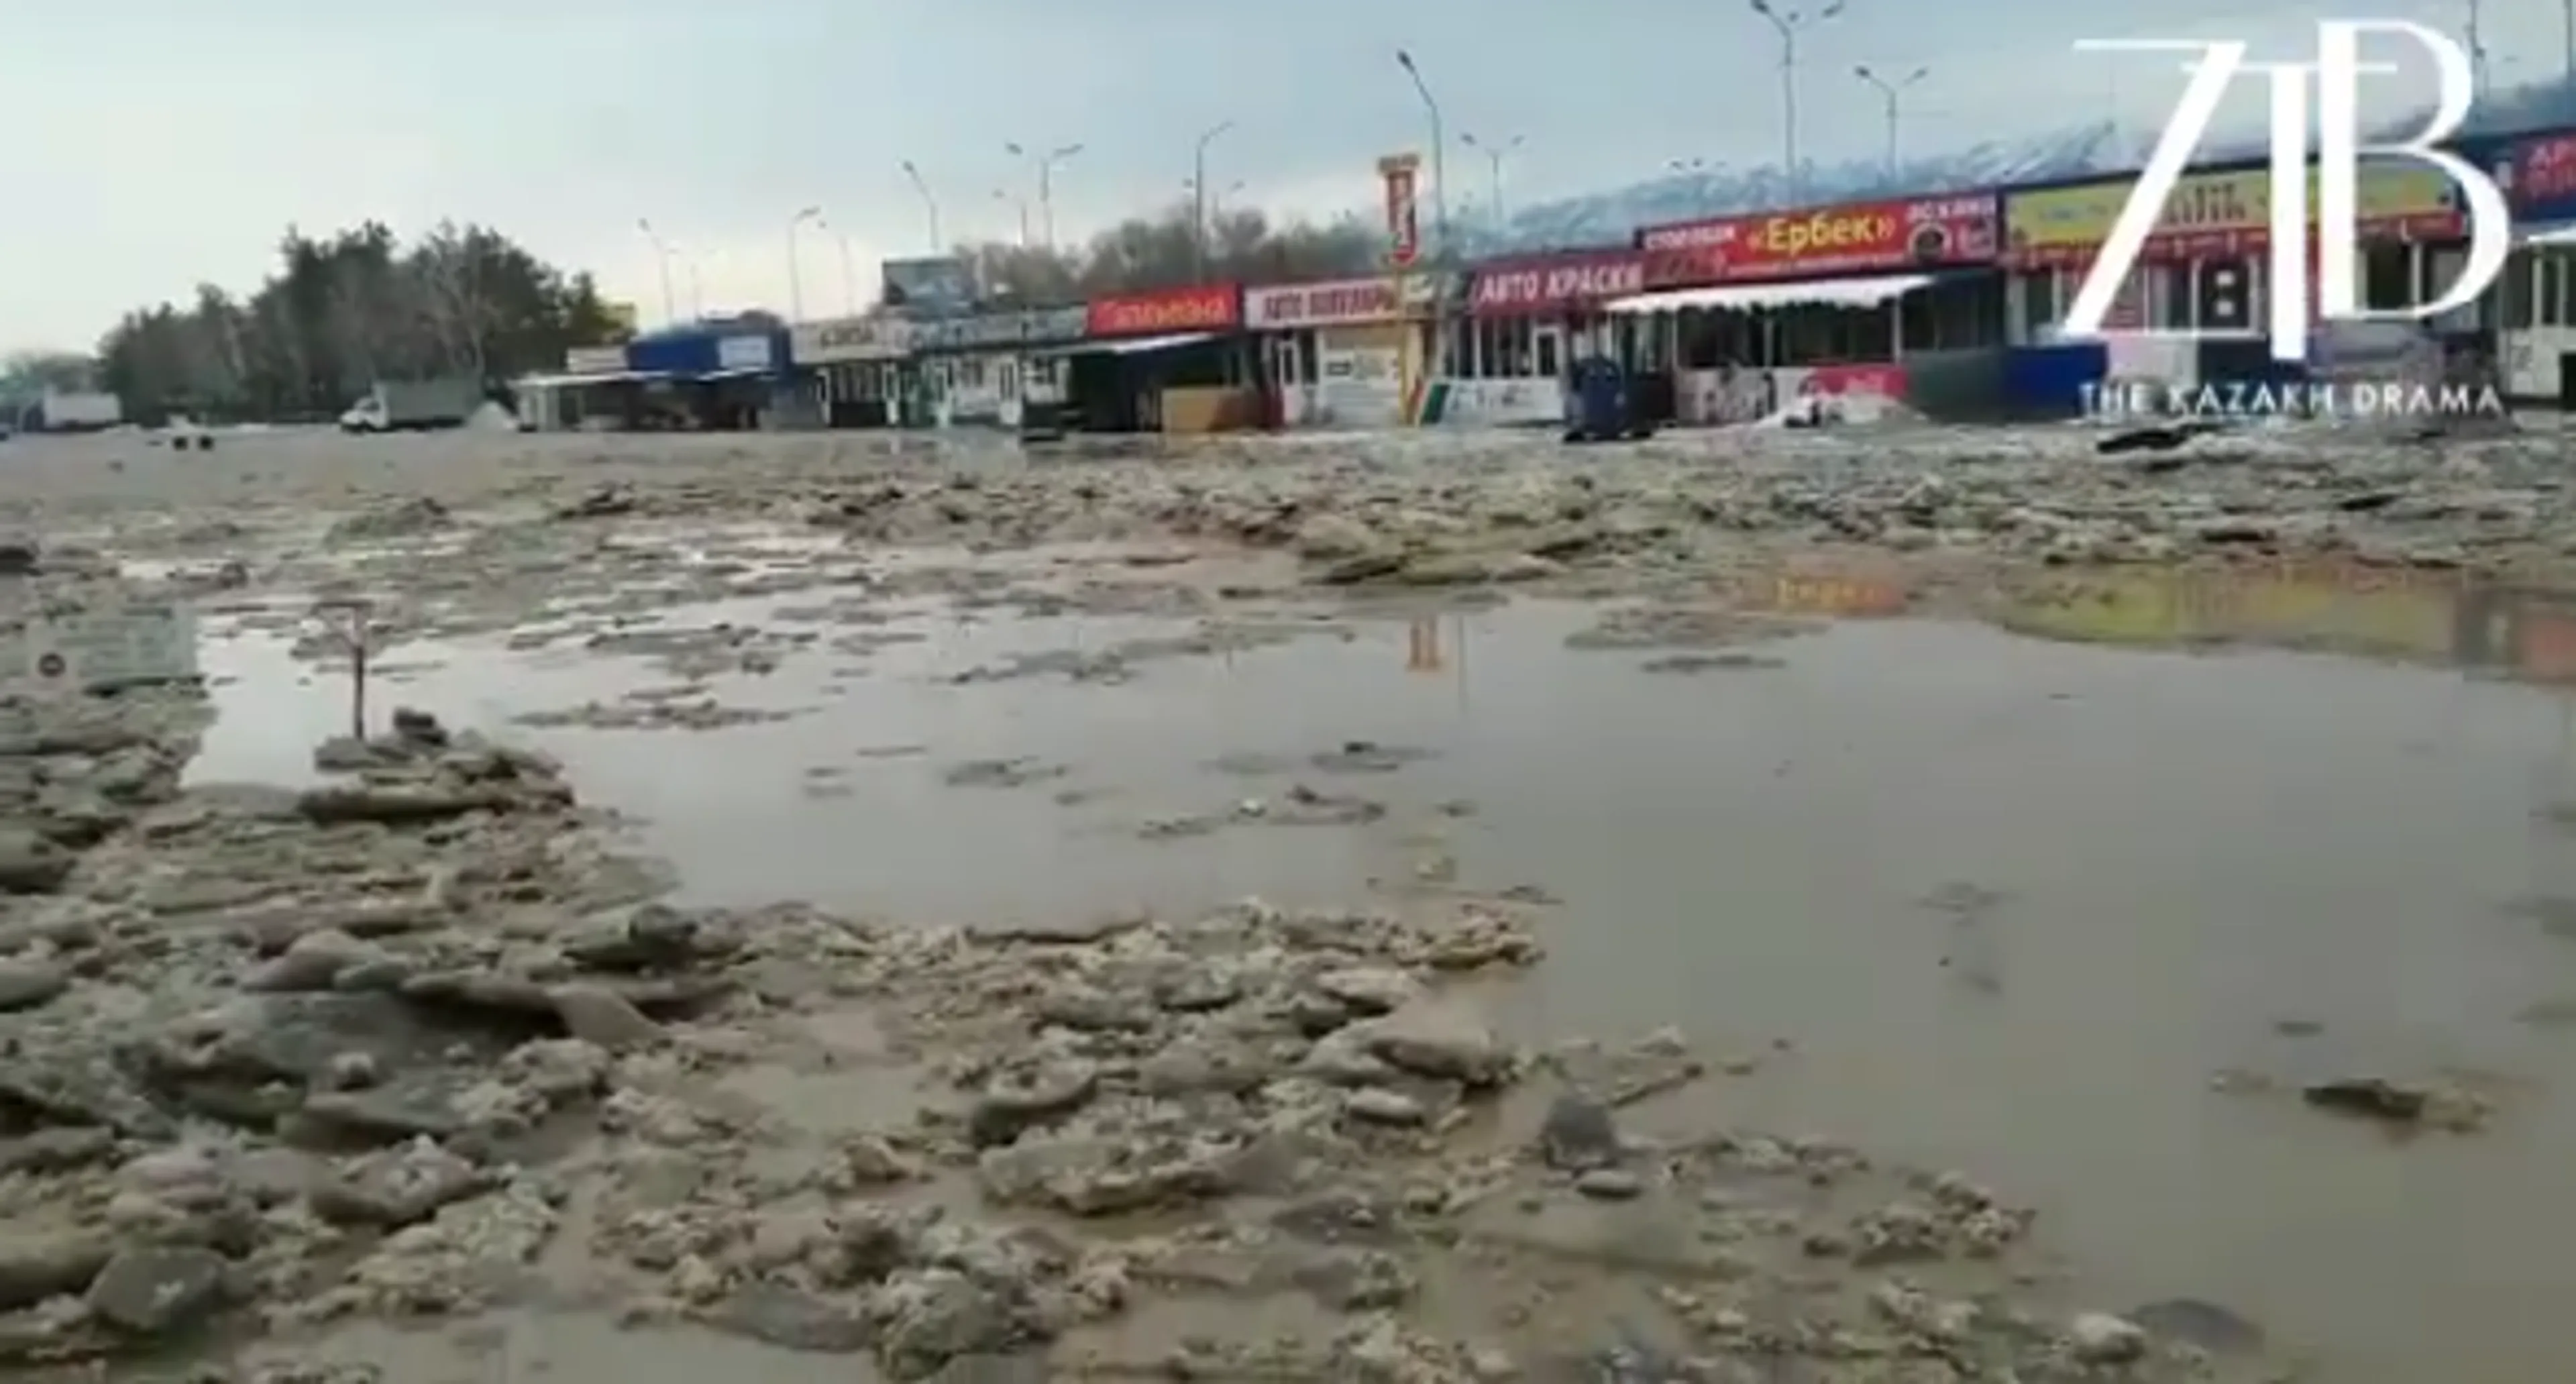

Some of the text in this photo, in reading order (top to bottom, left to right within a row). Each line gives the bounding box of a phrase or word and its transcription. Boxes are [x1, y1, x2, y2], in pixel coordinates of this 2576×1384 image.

[1746, 212, 1897, 258] «Ербек»
[1479, 262, 1644, 303] АВТО КРАСКИ
